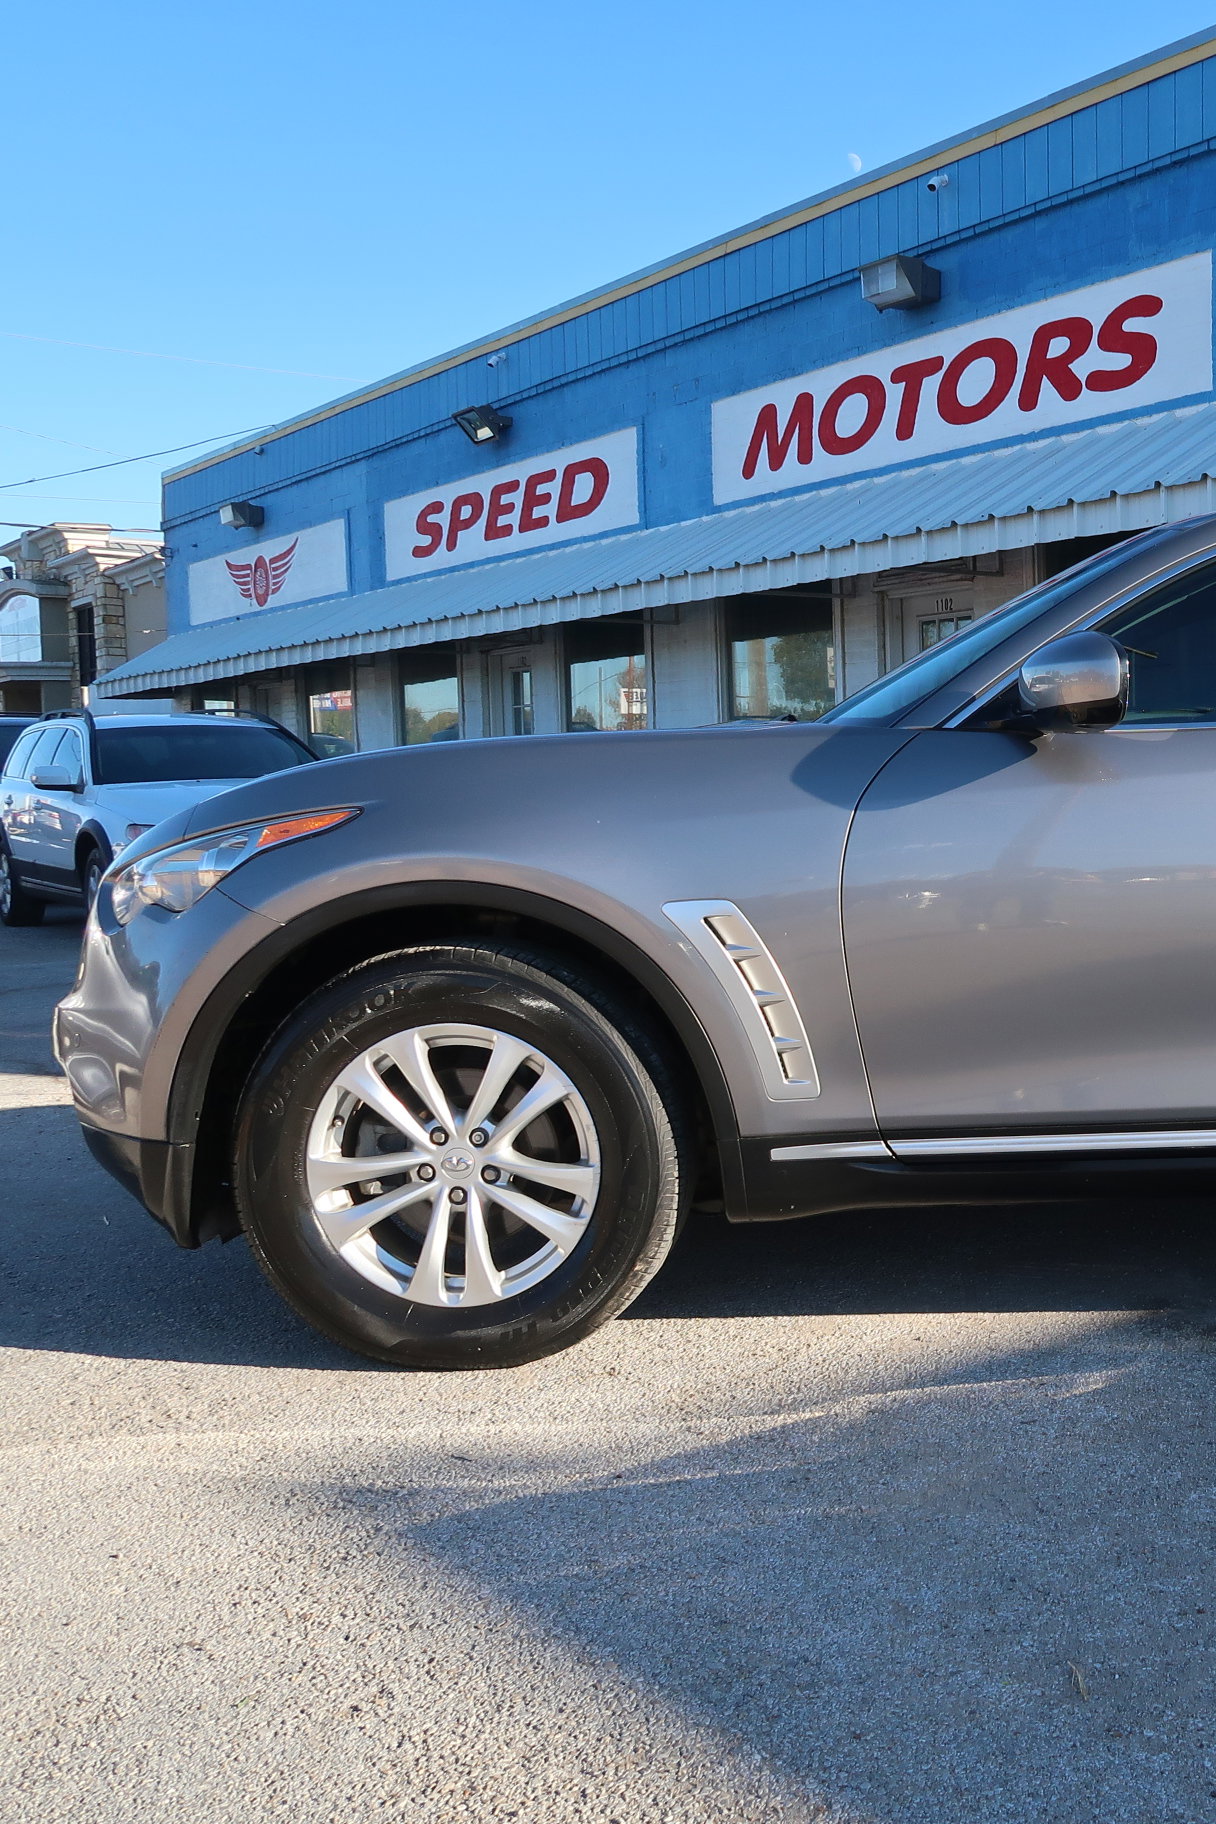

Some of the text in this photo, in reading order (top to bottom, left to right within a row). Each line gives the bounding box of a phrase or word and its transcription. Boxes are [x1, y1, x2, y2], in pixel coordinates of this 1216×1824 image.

[742, 294, 1164, 480] MOTORS
[411, 456, 610, 558] SPEED
[935, 598, 953, 612] 1102
